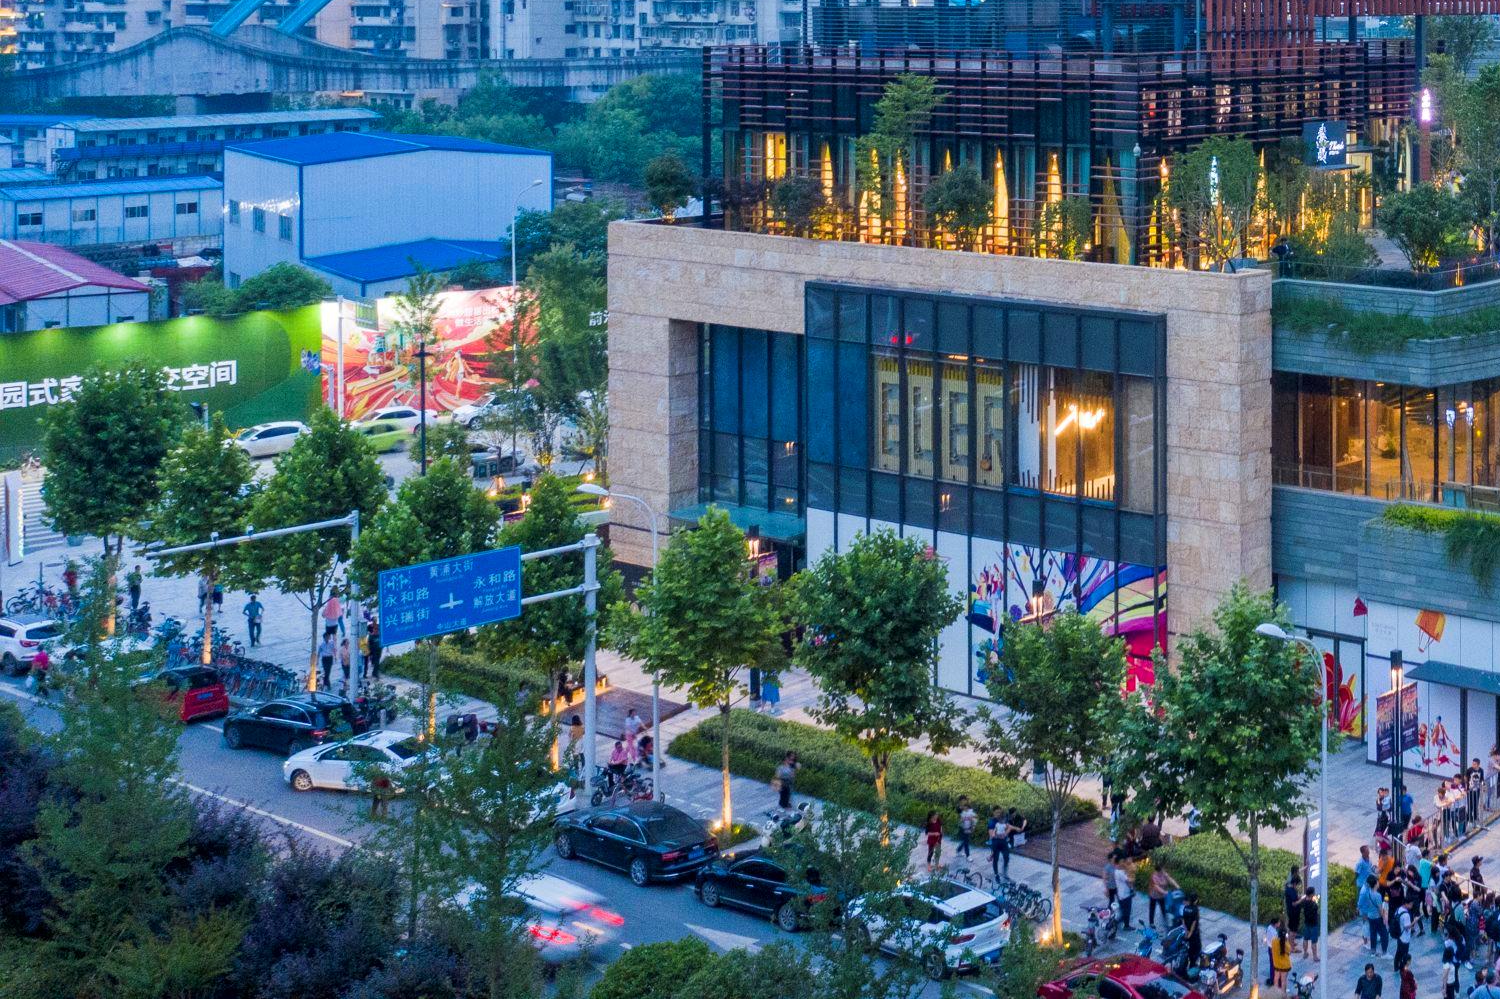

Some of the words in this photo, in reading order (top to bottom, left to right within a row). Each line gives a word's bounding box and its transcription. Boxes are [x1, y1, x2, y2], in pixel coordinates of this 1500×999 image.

[0, 360, 237, 411] 园式家交空间
[430, 560, 473, 579] 黄浦大街
[473, 569, 516, 590] 永和路
[385, 587, 430, 607] 永和路
[473, 589, 517, 609] 解放大道
[385, 608, 430, 628] 兴瑞街
